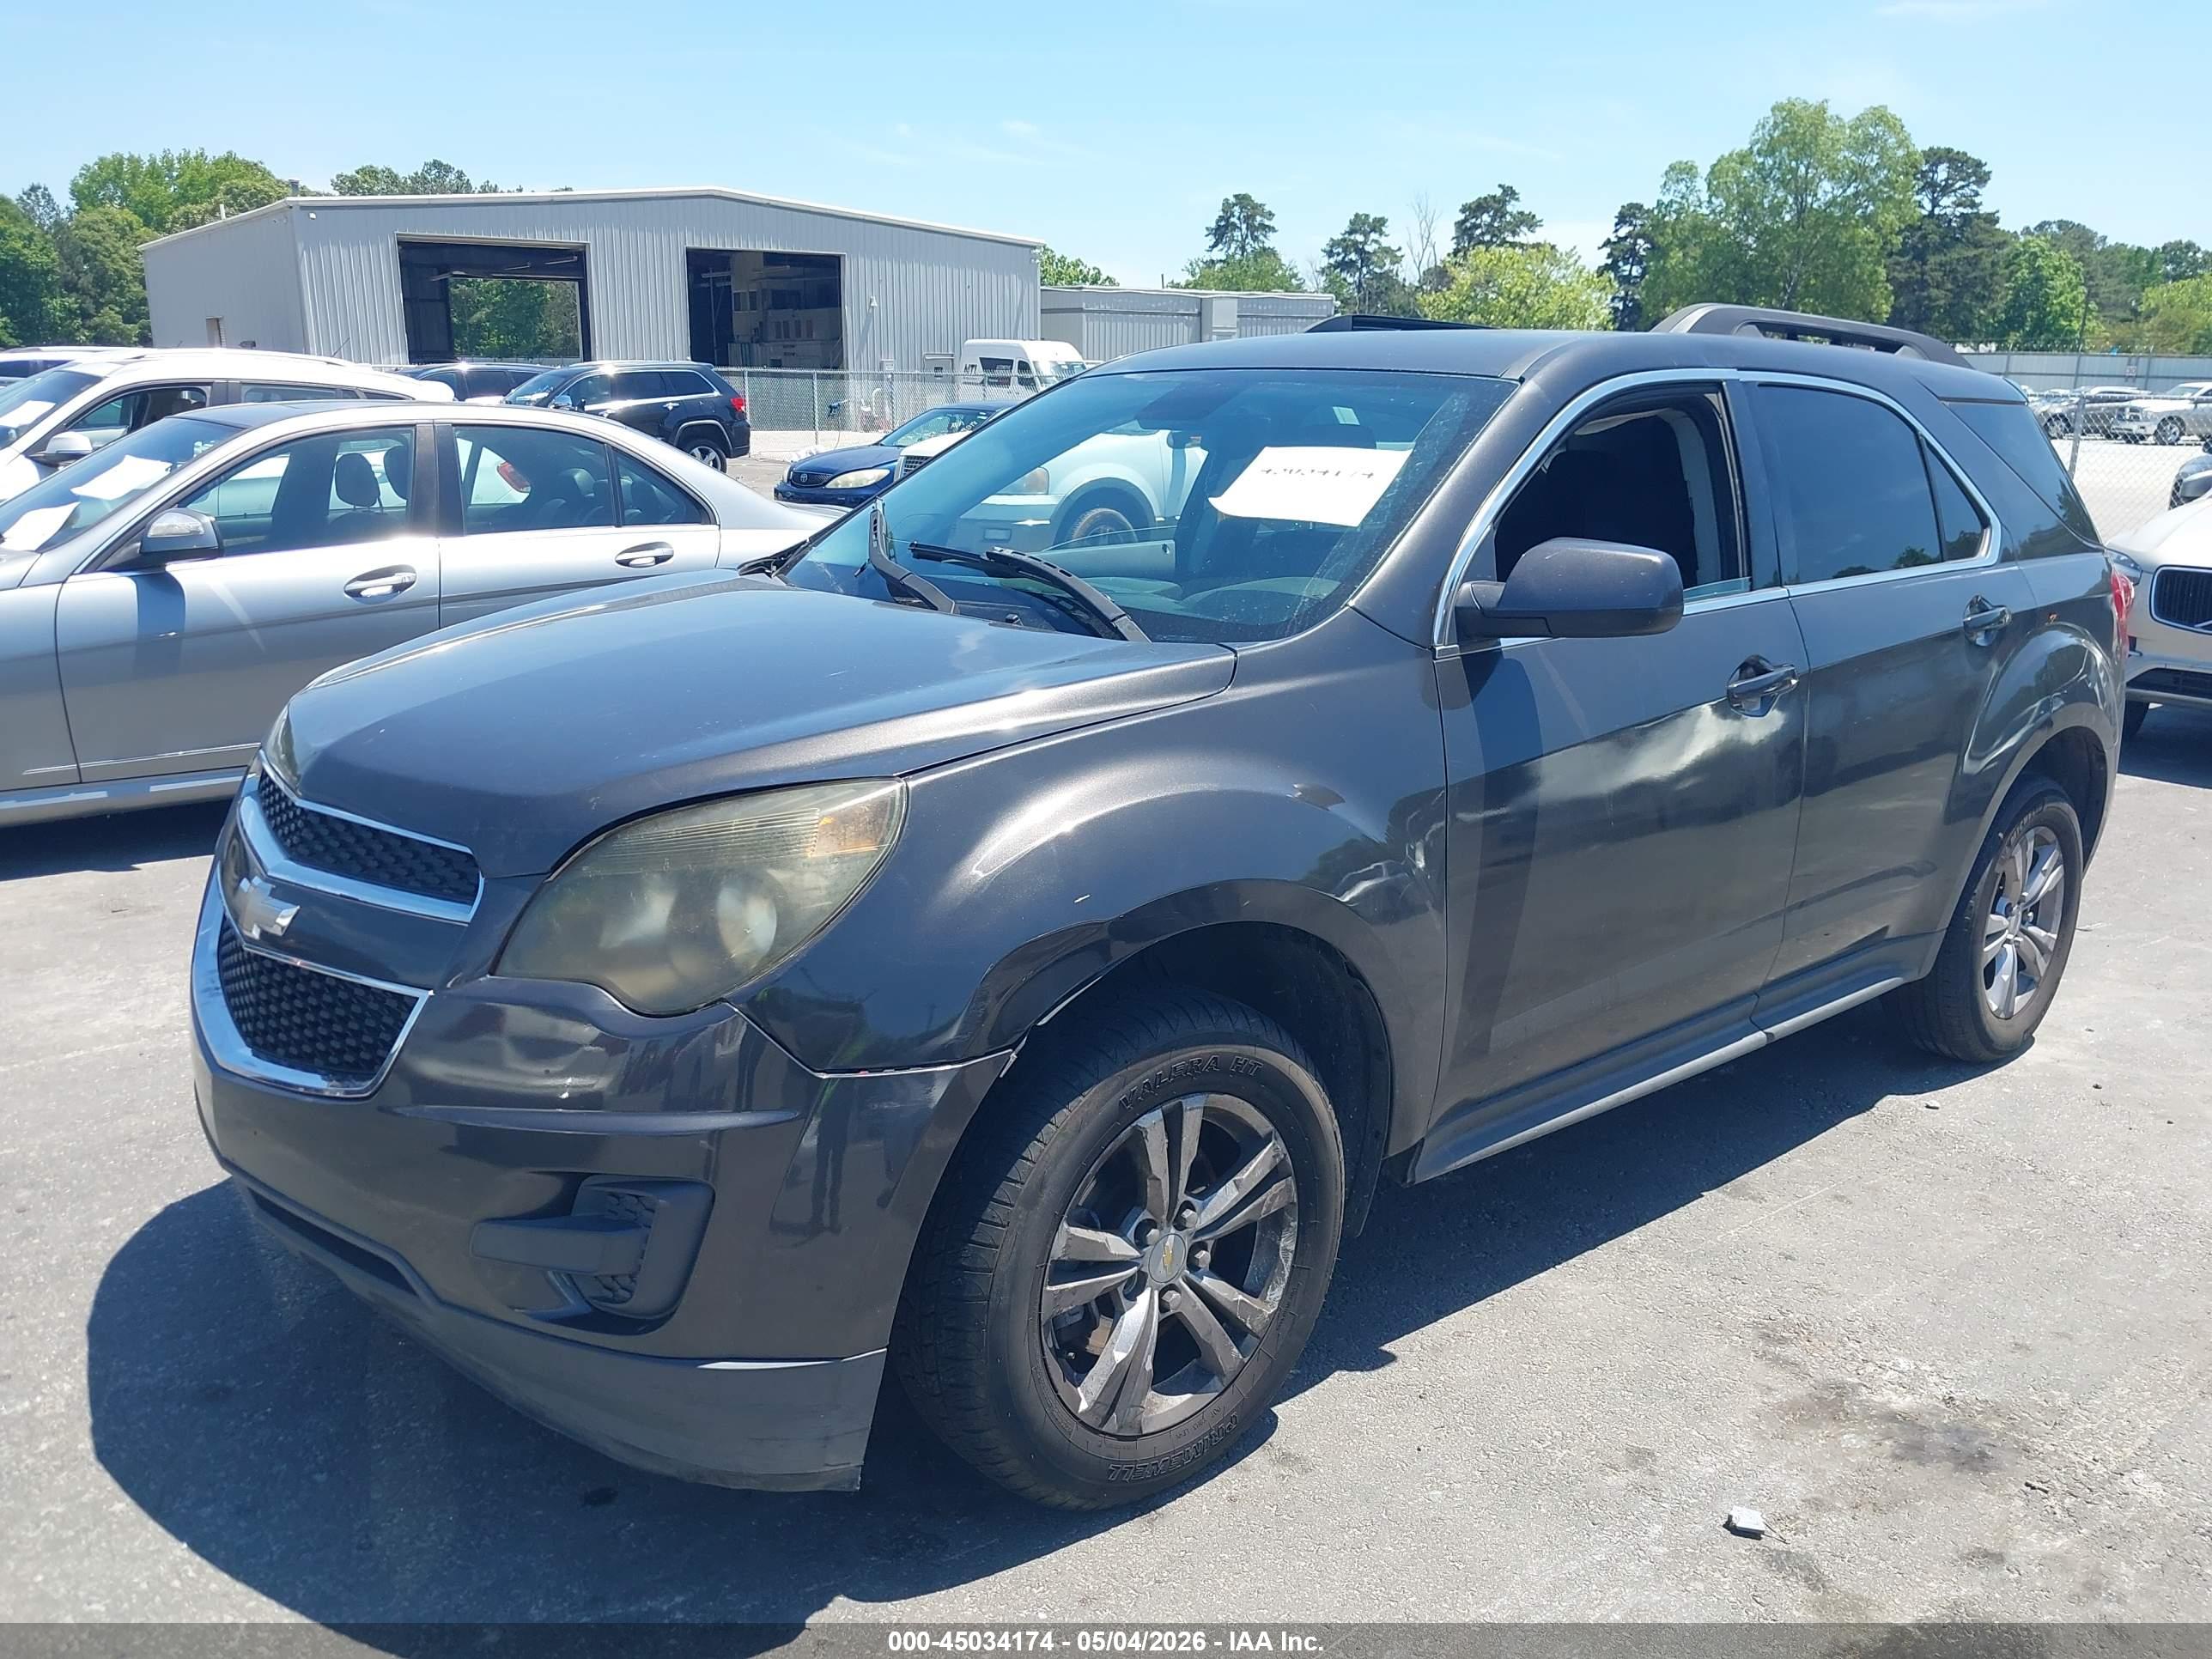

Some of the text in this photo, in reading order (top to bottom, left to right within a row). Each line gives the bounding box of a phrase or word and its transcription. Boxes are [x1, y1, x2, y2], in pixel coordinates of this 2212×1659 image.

[1120, 1054, 1263, 1109] VALERA HT
[1108, 1411, 1238, 1483] PRIMEWELL
